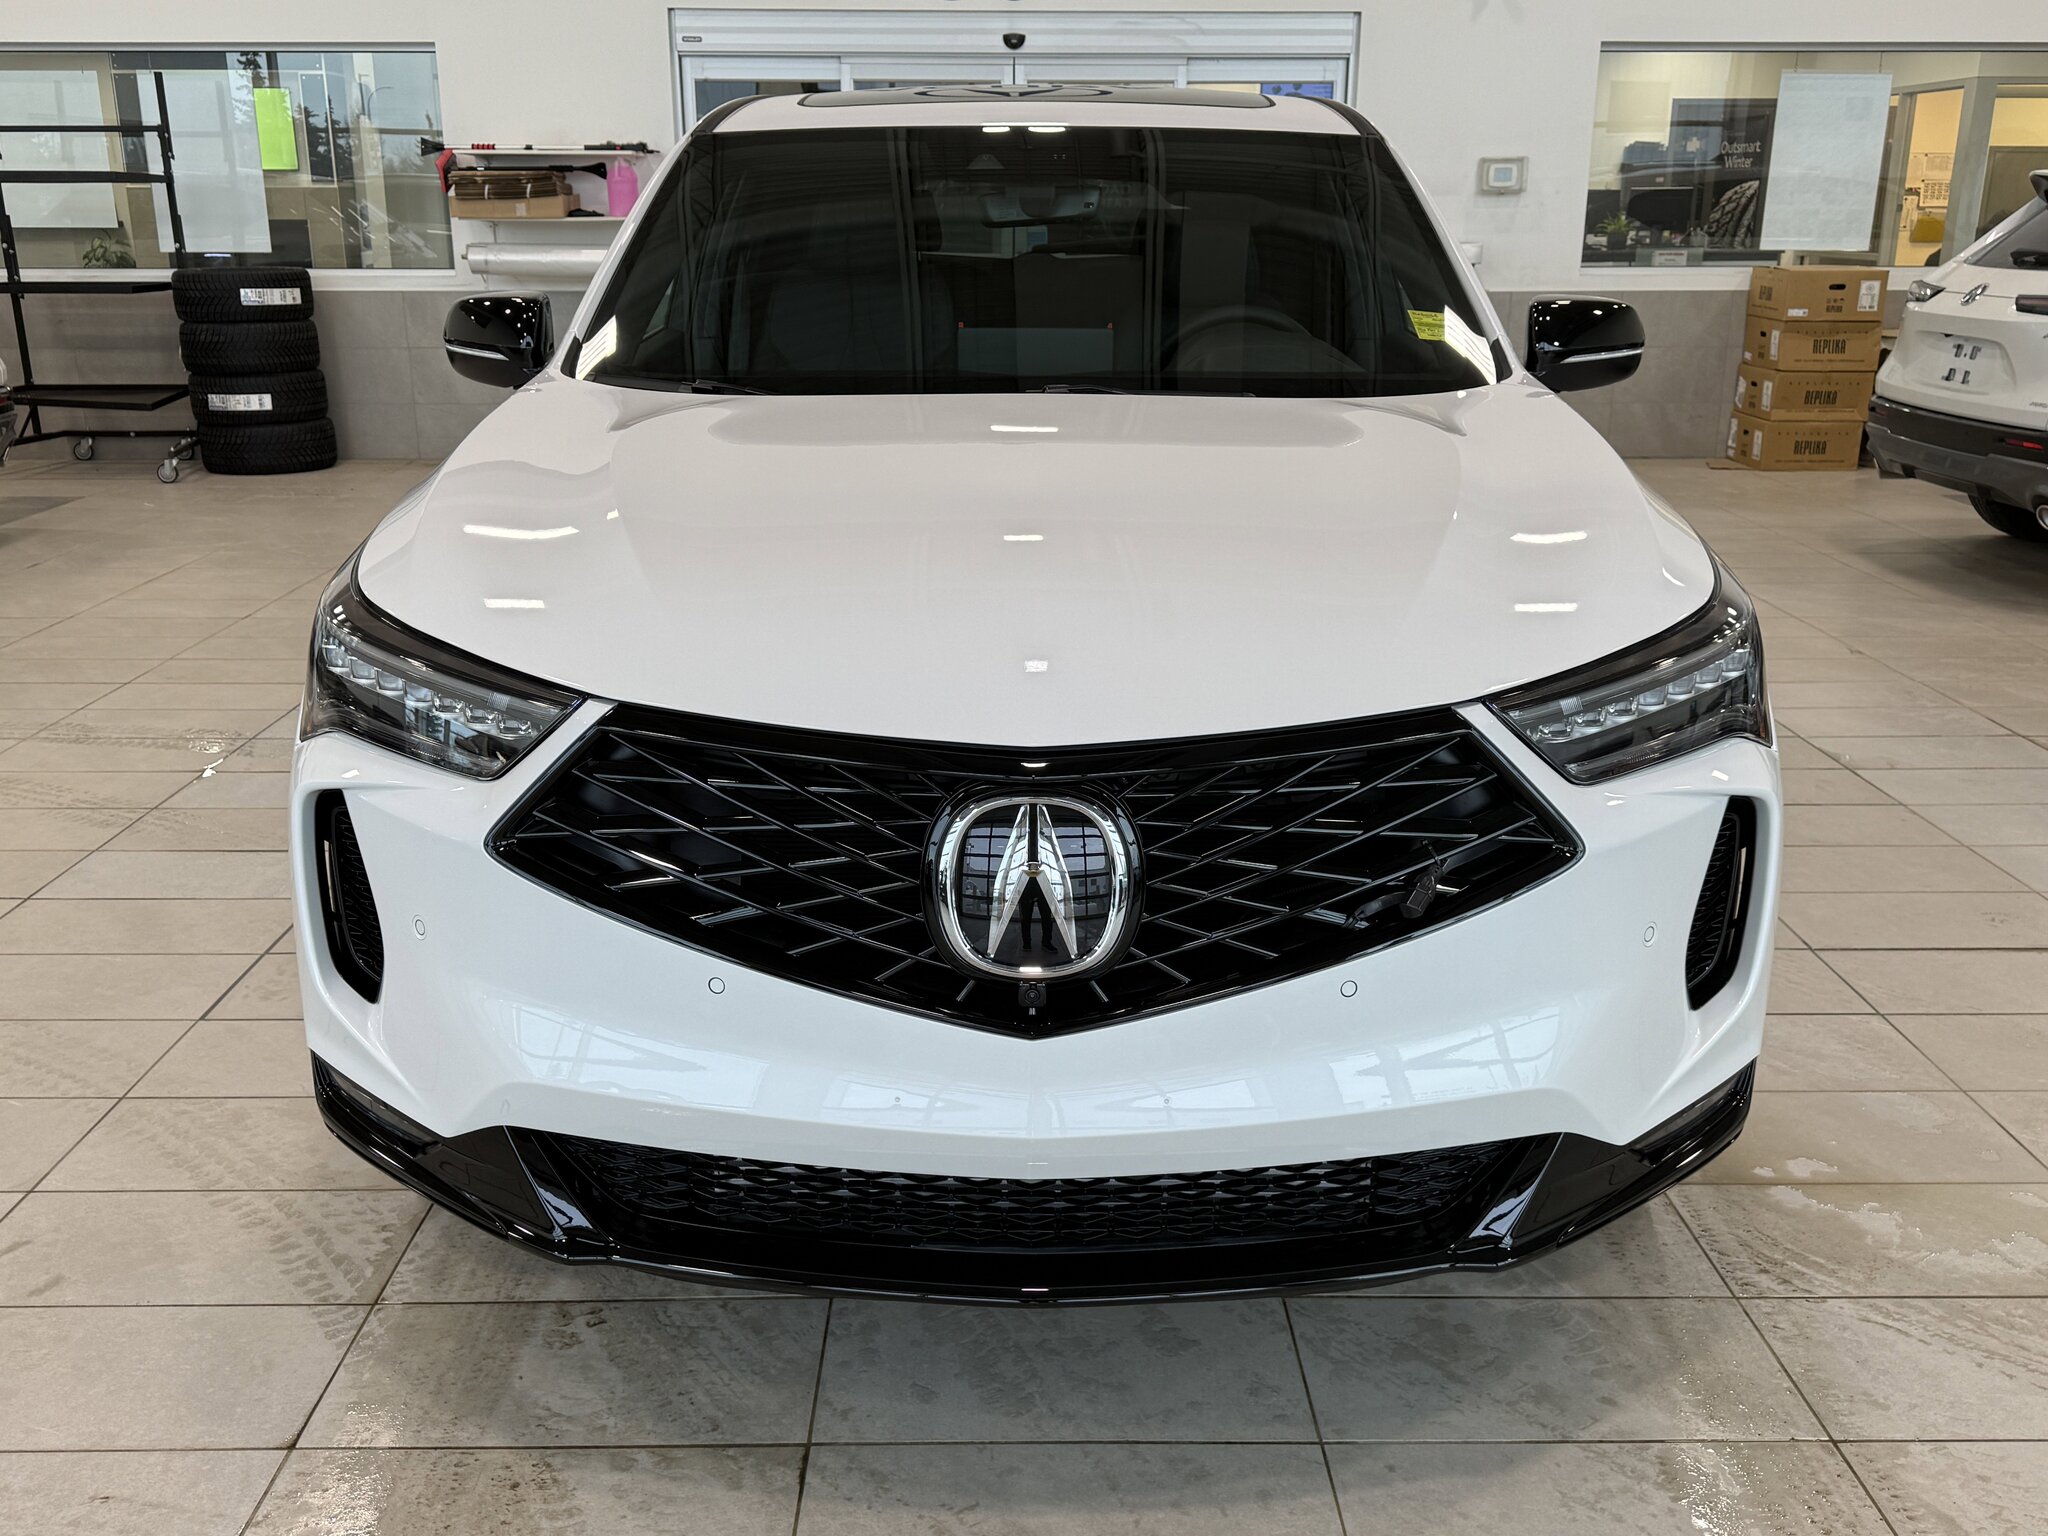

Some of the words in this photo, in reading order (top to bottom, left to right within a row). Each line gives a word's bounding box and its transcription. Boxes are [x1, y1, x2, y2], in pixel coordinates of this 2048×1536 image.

[1721, 140, 1761, 154] Outsmart
[1724, 155, 1753, 168] Winter
[1812, 338, 1847, 354] REPLIKA
[1804, 390, 1838, 405] REPLIKA
[1793, 440, 1827, 455] REPLIKA
